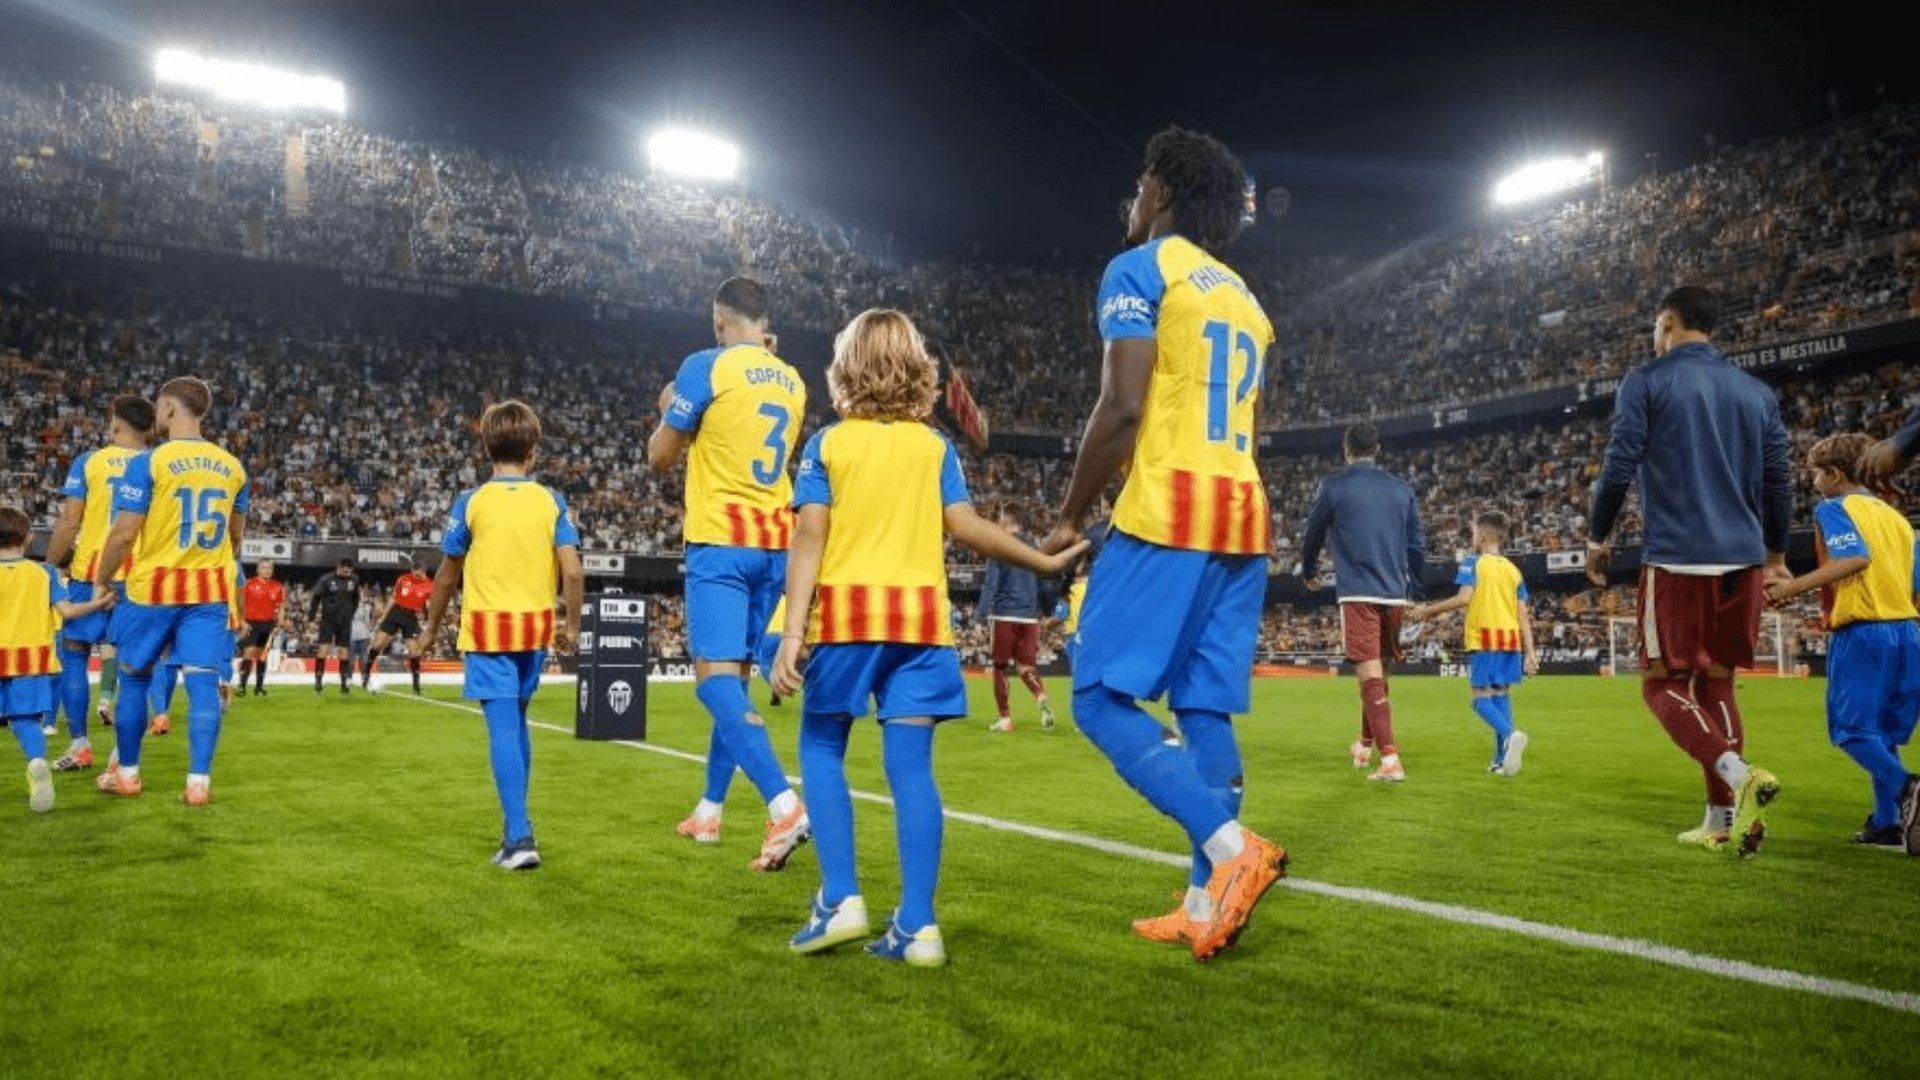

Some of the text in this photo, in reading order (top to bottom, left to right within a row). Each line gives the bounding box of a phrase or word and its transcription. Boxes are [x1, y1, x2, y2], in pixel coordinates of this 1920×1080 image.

[1760, 349, 1777, 365] ES
[1780, 335, 1847, 361] MESTALLA
[745, 367, 796, 394] COPETE
[751, 402, 789, 485] 3
[174, 487, 228, 549] 15
